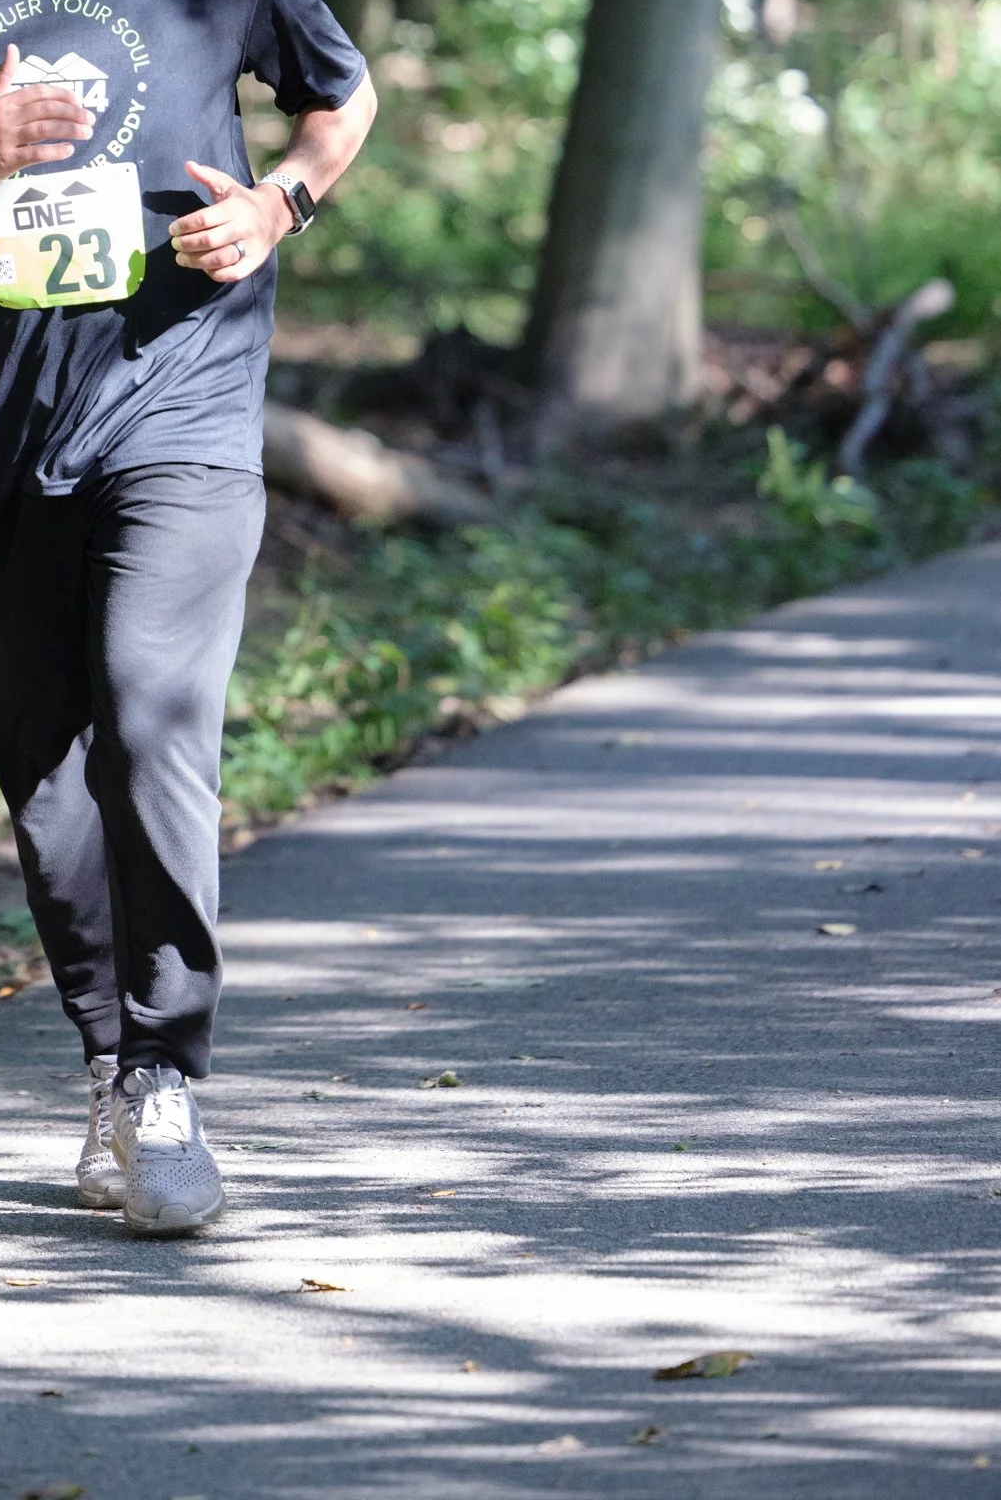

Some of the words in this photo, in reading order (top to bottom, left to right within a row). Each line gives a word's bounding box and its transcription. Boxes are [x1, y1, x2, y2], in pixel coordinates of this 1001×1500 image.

[111, 17, 150, 73] SOUL
[106, 98, 146, 158] BODY
[13, 200, 75, 231] ONE
[39, 228, 117, 296] 23
